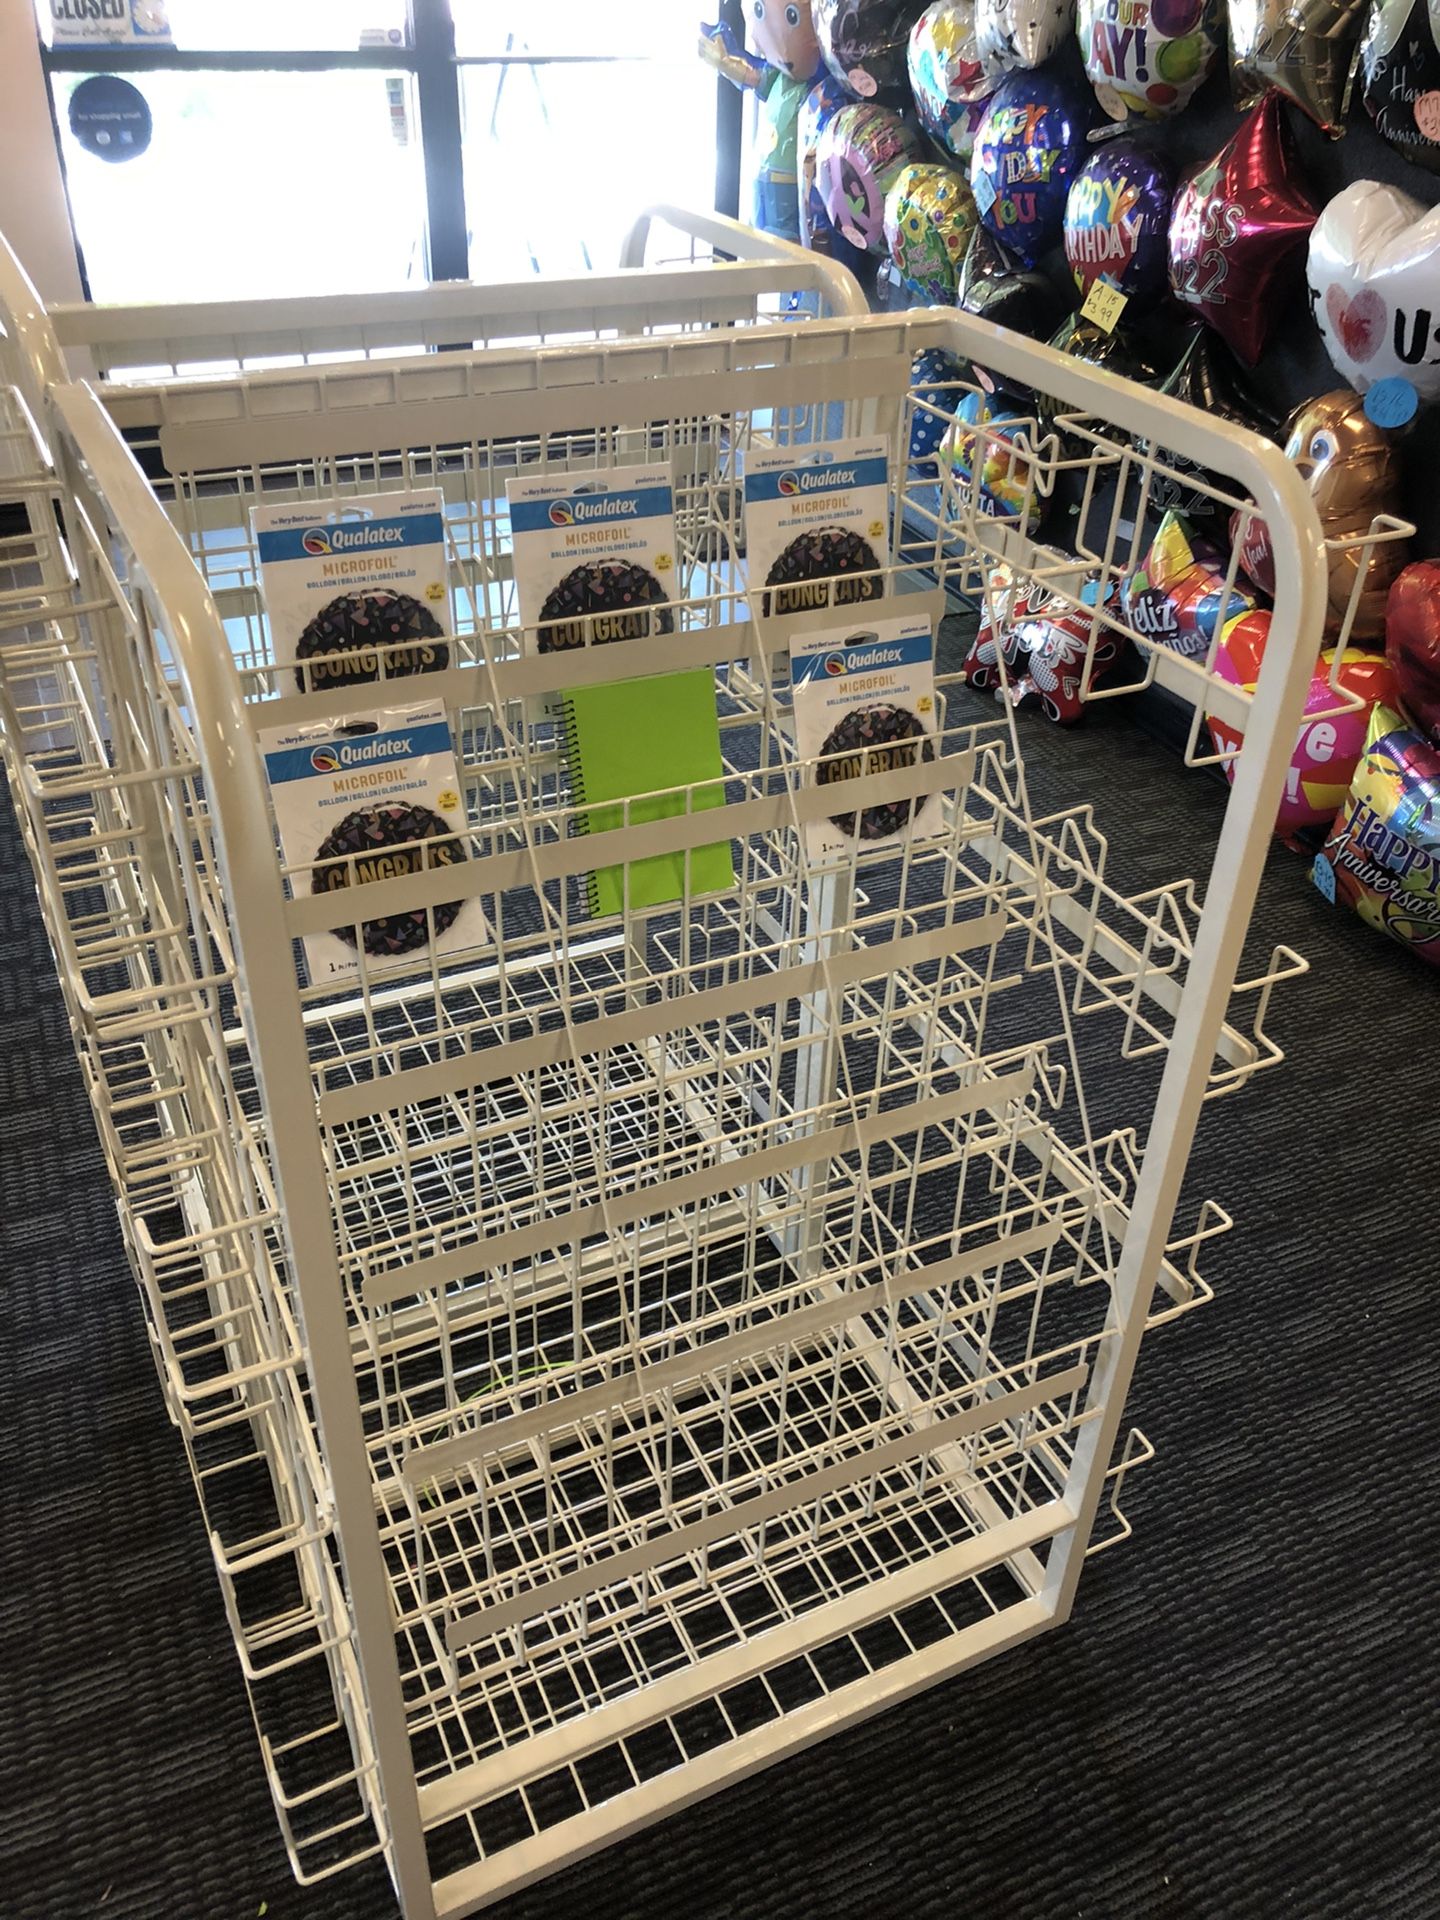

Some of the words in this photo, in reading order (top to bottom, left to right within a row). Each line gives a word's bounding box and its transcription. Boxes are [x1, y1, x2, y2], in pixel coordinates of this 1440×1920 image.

[1393, 308, 1440, 366] U
[800, 469, 857, 490] Qualatex
[575, 499, 638, 521] Qualatex
[332, 526, 405, 549] Qualatex
[847, 647, 903, 670] Qualatex
[340, 737, 413, 765] Qualatex
[1323, 832, 1440, 924] Anniversar
